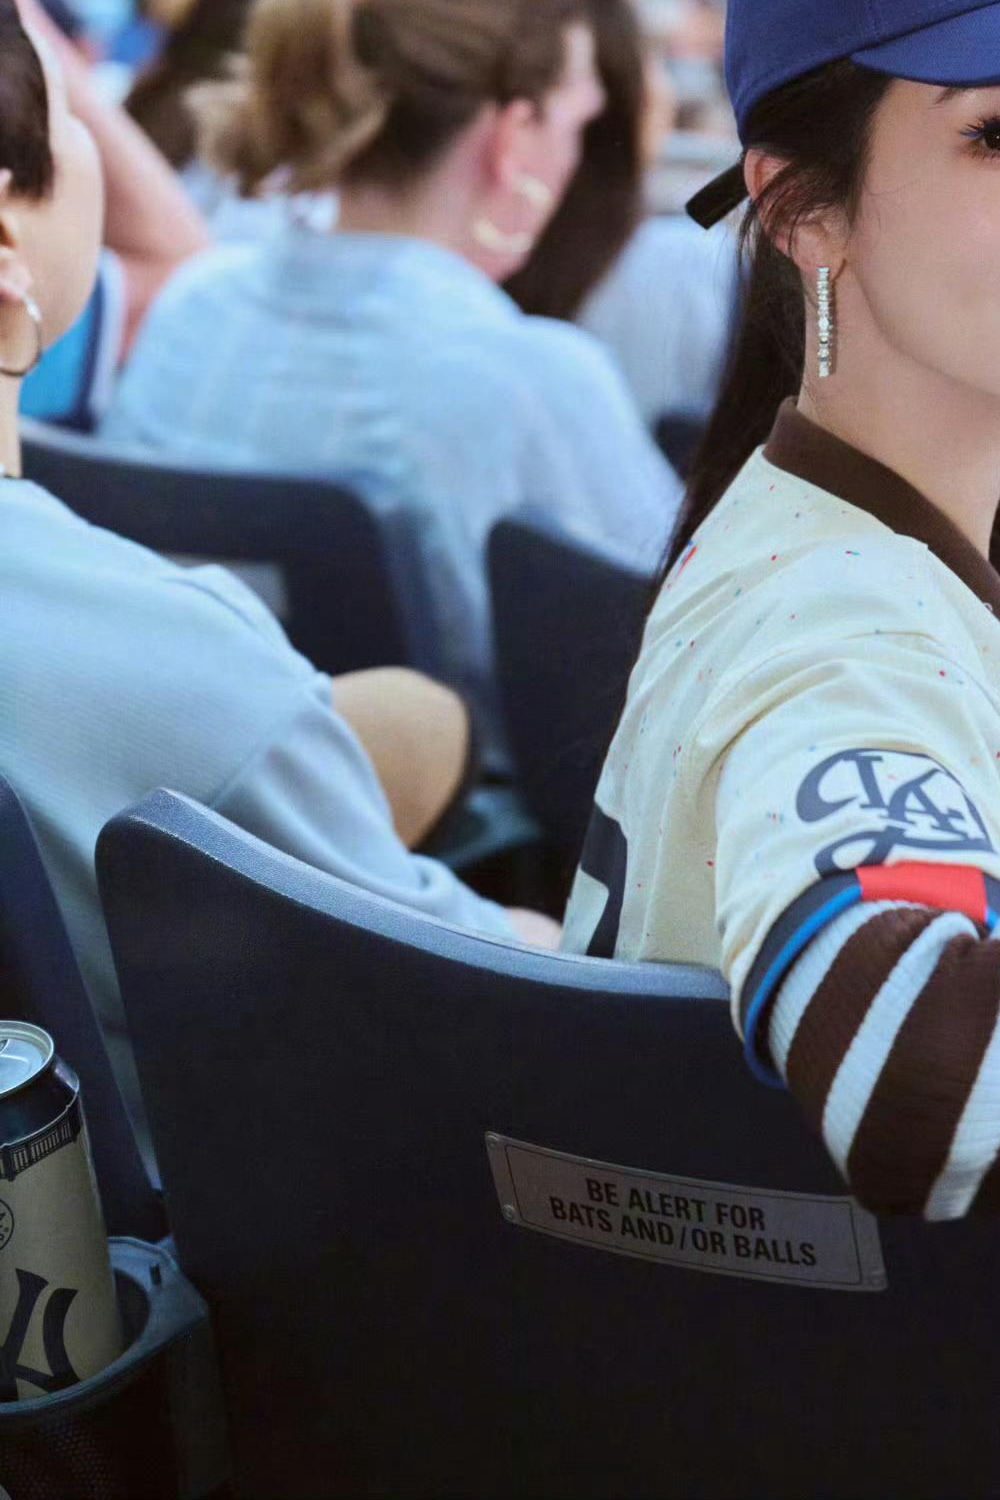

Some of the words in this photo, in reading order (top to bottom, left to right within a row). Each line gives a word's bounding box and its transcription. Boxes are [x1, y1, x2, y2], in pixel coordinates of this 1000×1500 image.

[550, 1196, 613, 1233] BATS
[733, 1234, 817, 1267] BALLS
[585, 1178, 620, 1207] BE
[628, 1187, 706, 1223] ALERT
[715, 1202, 766, 1232] FOR
